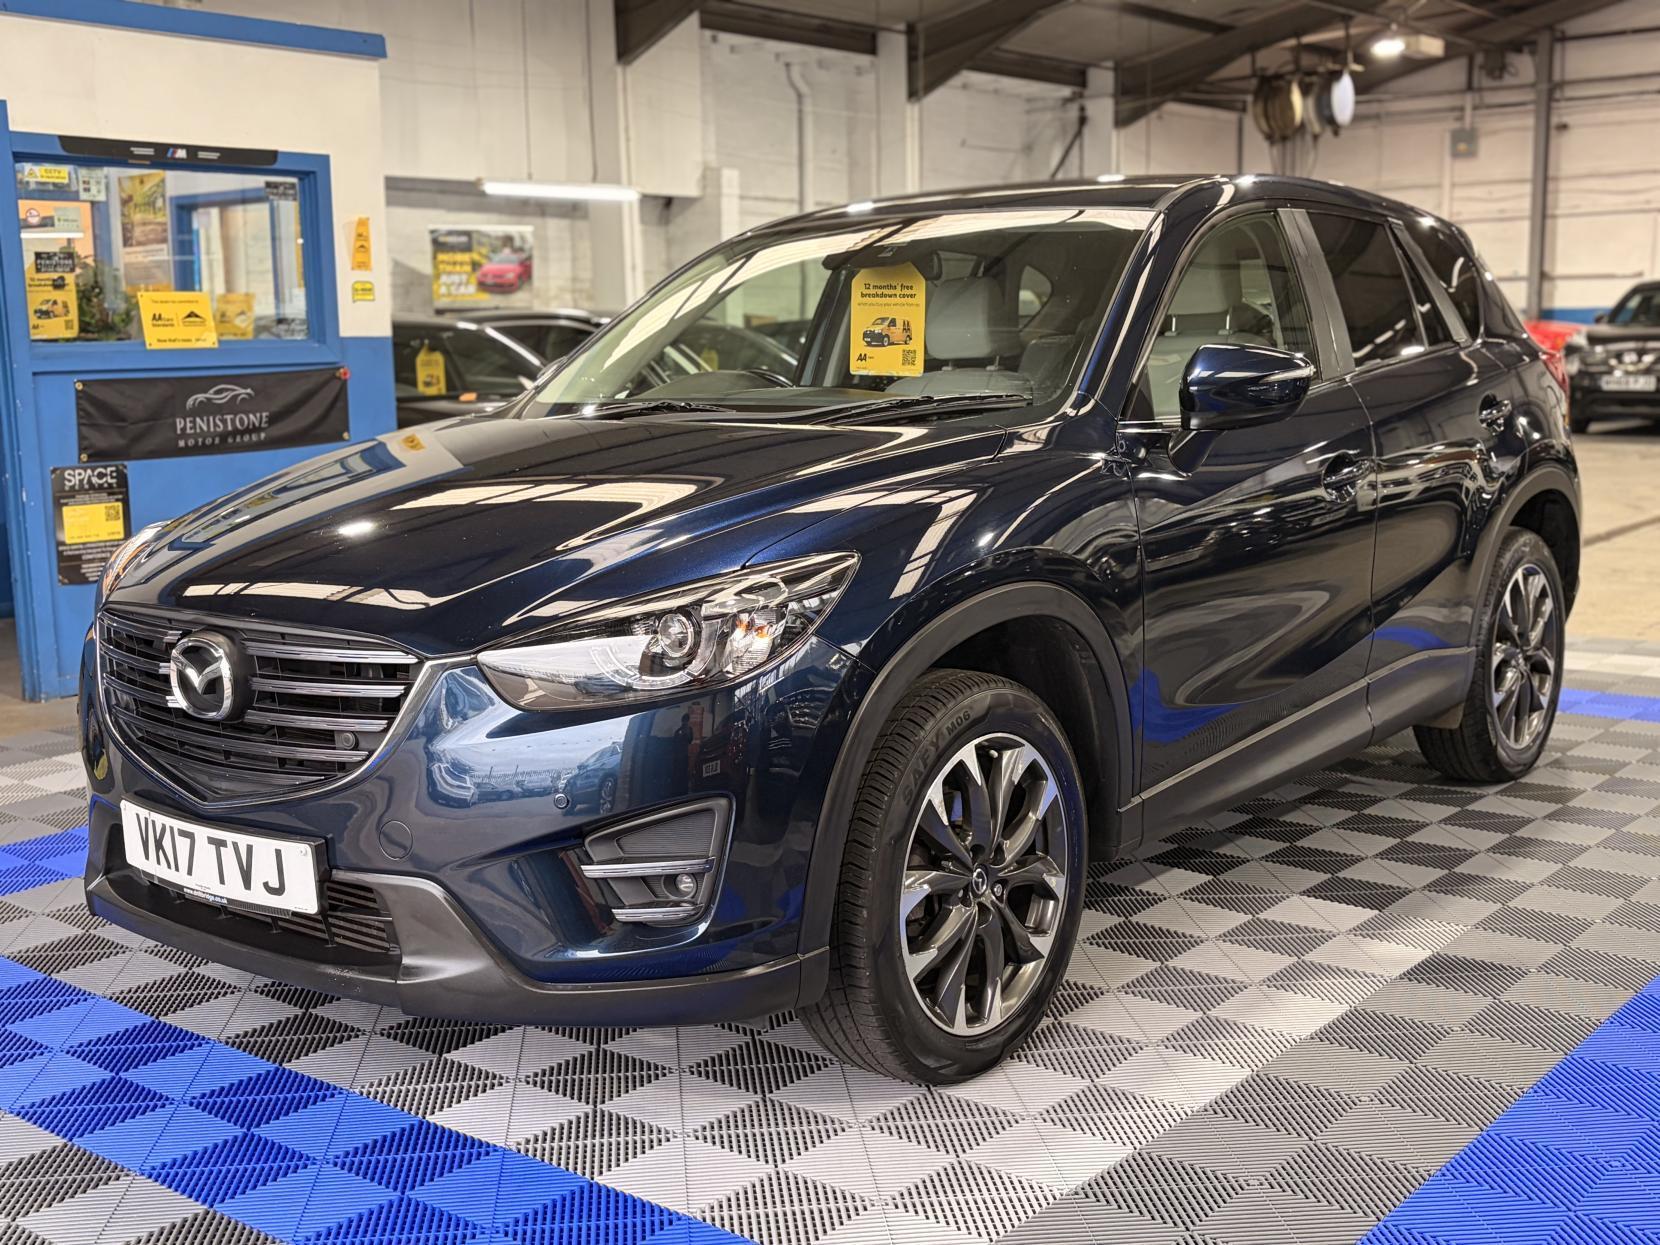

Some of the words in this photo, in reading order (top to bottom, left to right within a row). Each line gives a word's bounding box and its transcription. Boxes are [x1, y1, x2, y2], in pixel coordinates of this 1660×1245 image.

[900, 283, 914, 291] free
[860, 291, 898, 299] breakdown
[152, 312, 162, 322] AA
[856, 353, 867, 362] AA
[175, 411, 270, 435] PENISTONE
[178, 436, 220, 448] MOTOR
[227, 431, 267, 444] GROUP
[64, 466, 118, 487] SPACE
[135, 812, 196, 877] VK17
[207, 835, 286, 897] TVJ
